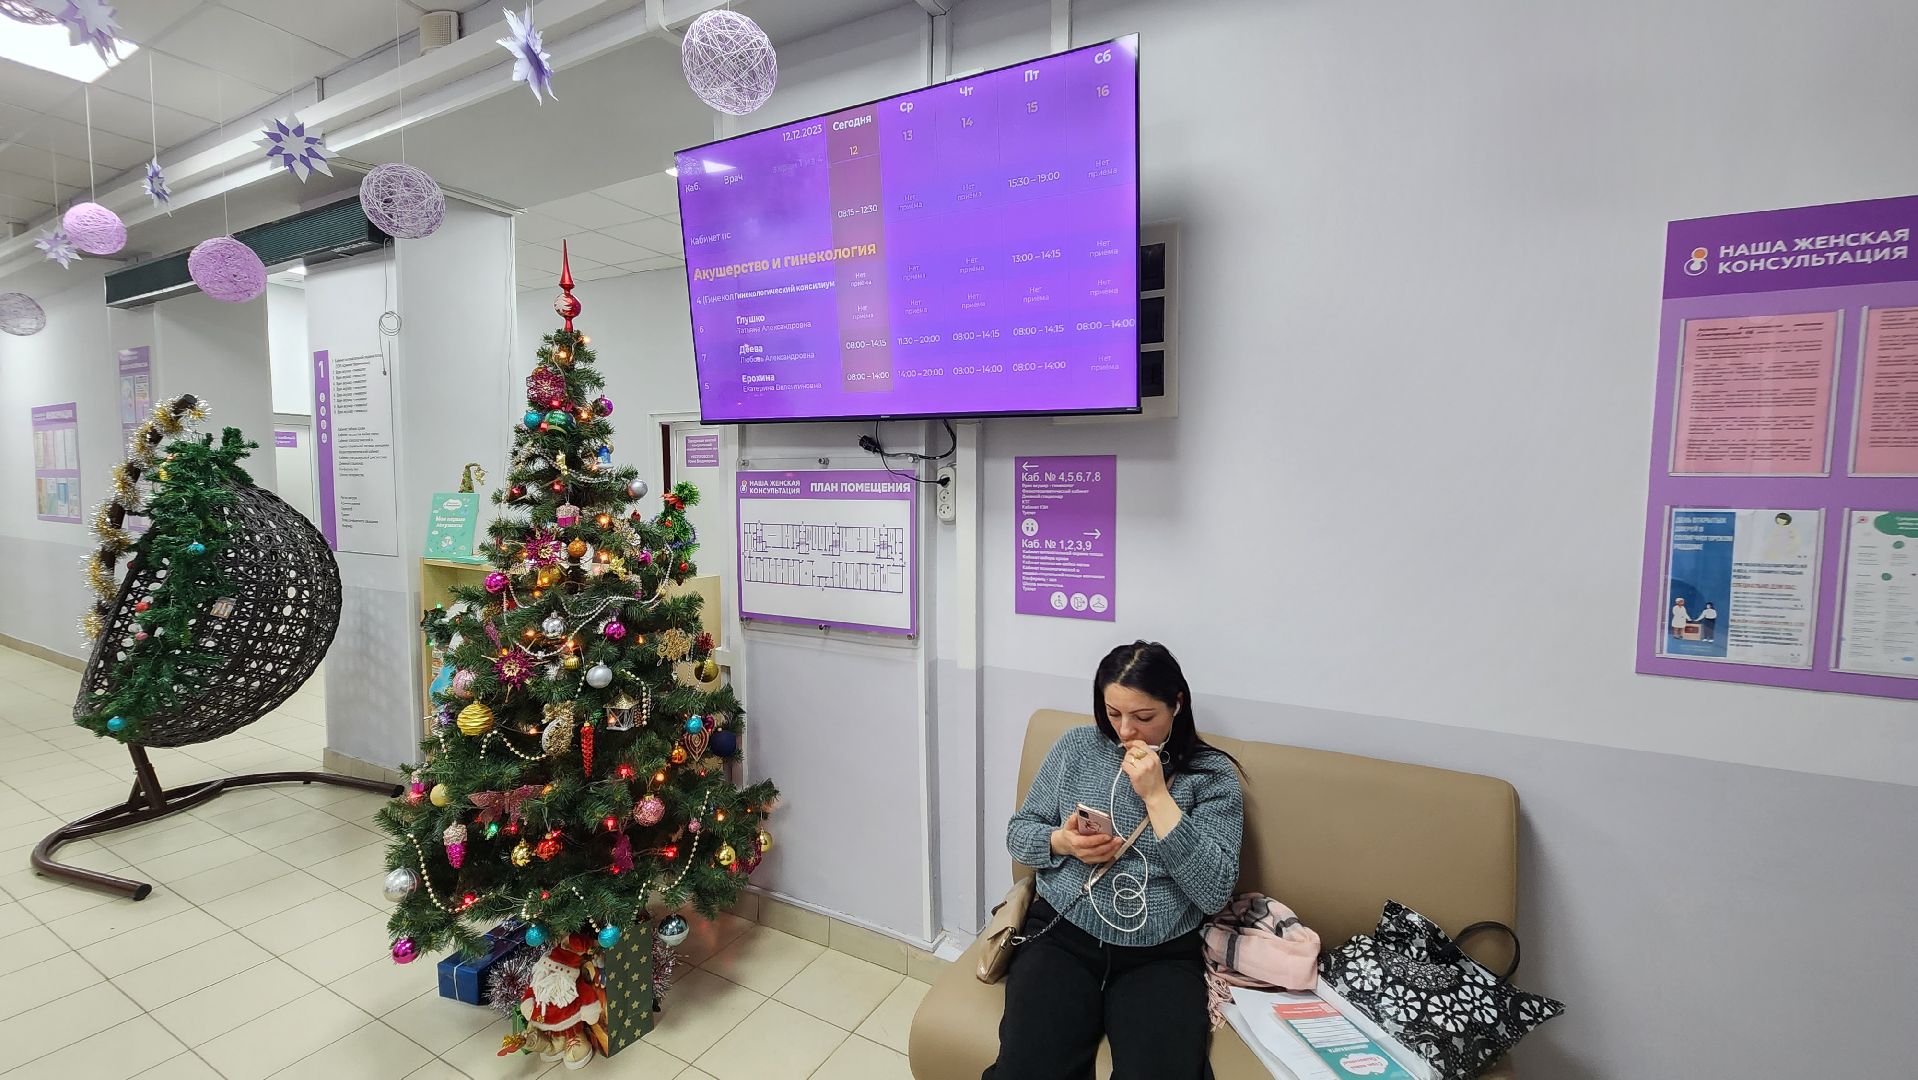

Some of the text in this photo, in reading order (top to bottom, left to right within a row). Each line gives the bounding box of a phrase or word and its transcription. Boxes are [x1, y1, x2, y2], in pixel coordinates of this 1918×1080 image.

[1094, 50, 1112, 64] Сб
[1024, 70, 1040, 81] Пт
[960, 86, 974, 96] Чт
[1096, 86, 1110, 98] 16
[900, 102, 914, 114] Ср
[1027, 102, 1038, 113] 15
[832, 115, 872, 130] Сегодня
[962, 118, 974, 128] 14
[782, 124, 822, 141] 12.12.2023
[903, 130, 913, 140] 13
[850, 146, 858, 155] 12
[1037, 172, 1060, 182] 19:00
[1719, 228, 1910, 258] НАША ЖЕНСКАЯ
[694, 243, 876, 282] Акушерство и гинекология
[1012, 253, 1033, 263] 13:00
[1718, 246, 1908, 274] КОНСУЛЬТАЦИЯ
[736, 315, 765, 325] Глушко
[742, 374, 775, 384] Ерохина
[1022, 472, 1041, 481] Каб.
[1045, 472, 1056, 481] №
[810, 482, 911, 493] ПЛАН ПОМЕЩЕНИЯ
[1022, 539, 1092, 551] Каб. № 1,2,3,9
